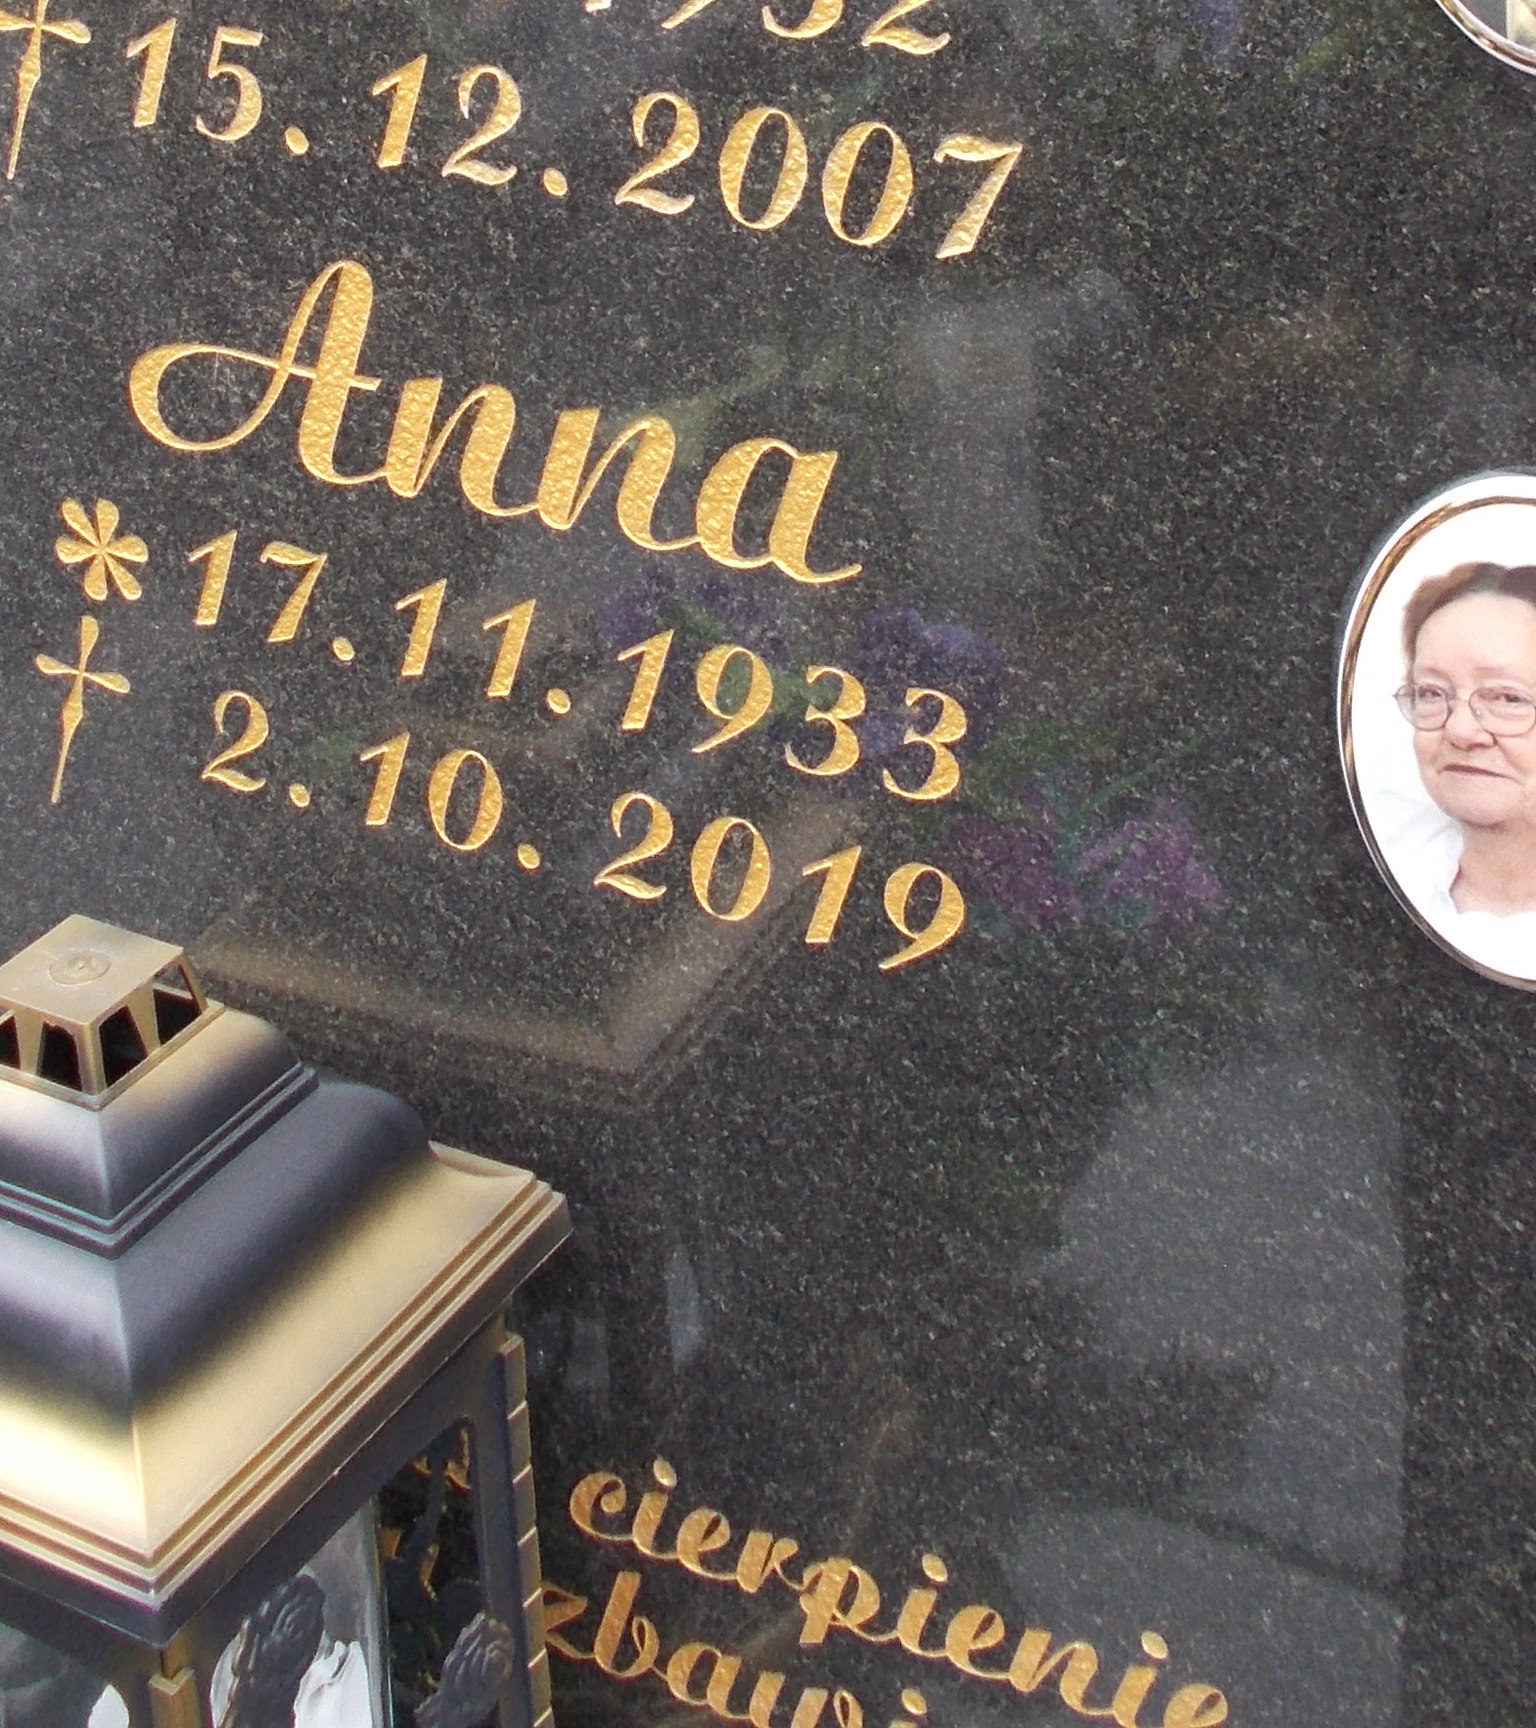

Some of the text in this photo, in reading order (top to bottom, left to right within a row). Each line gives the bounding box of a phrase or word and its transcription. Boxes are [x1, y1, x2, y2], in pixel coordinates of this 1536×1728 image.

[614, 89, 1025, 261] 2007
[127, 258, 865, 586] Anna
[616, 628, 970, 805] 1933
[593, 789, 969, 972] 2019
[568, 1454, 1229, 1728] cierpienie
